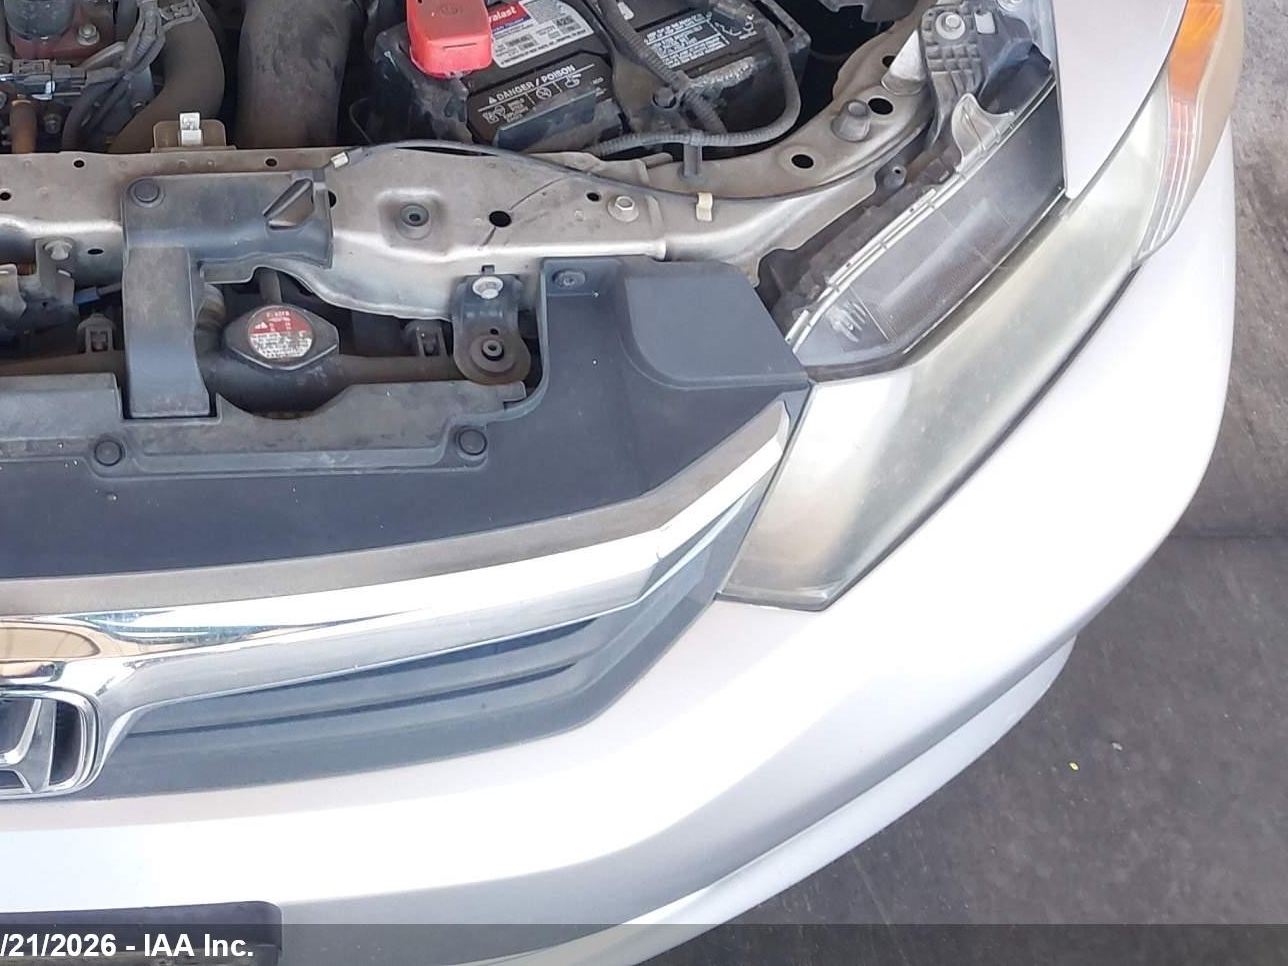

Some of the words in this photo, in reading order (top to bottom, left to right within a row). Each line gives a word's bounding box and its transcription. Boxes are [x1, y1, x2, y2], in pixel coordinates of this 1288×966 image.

[488, 5, 518, 23] ralast
[496, 81, 535, 101] DANGER
[541, 64, 576, 83] POISON
